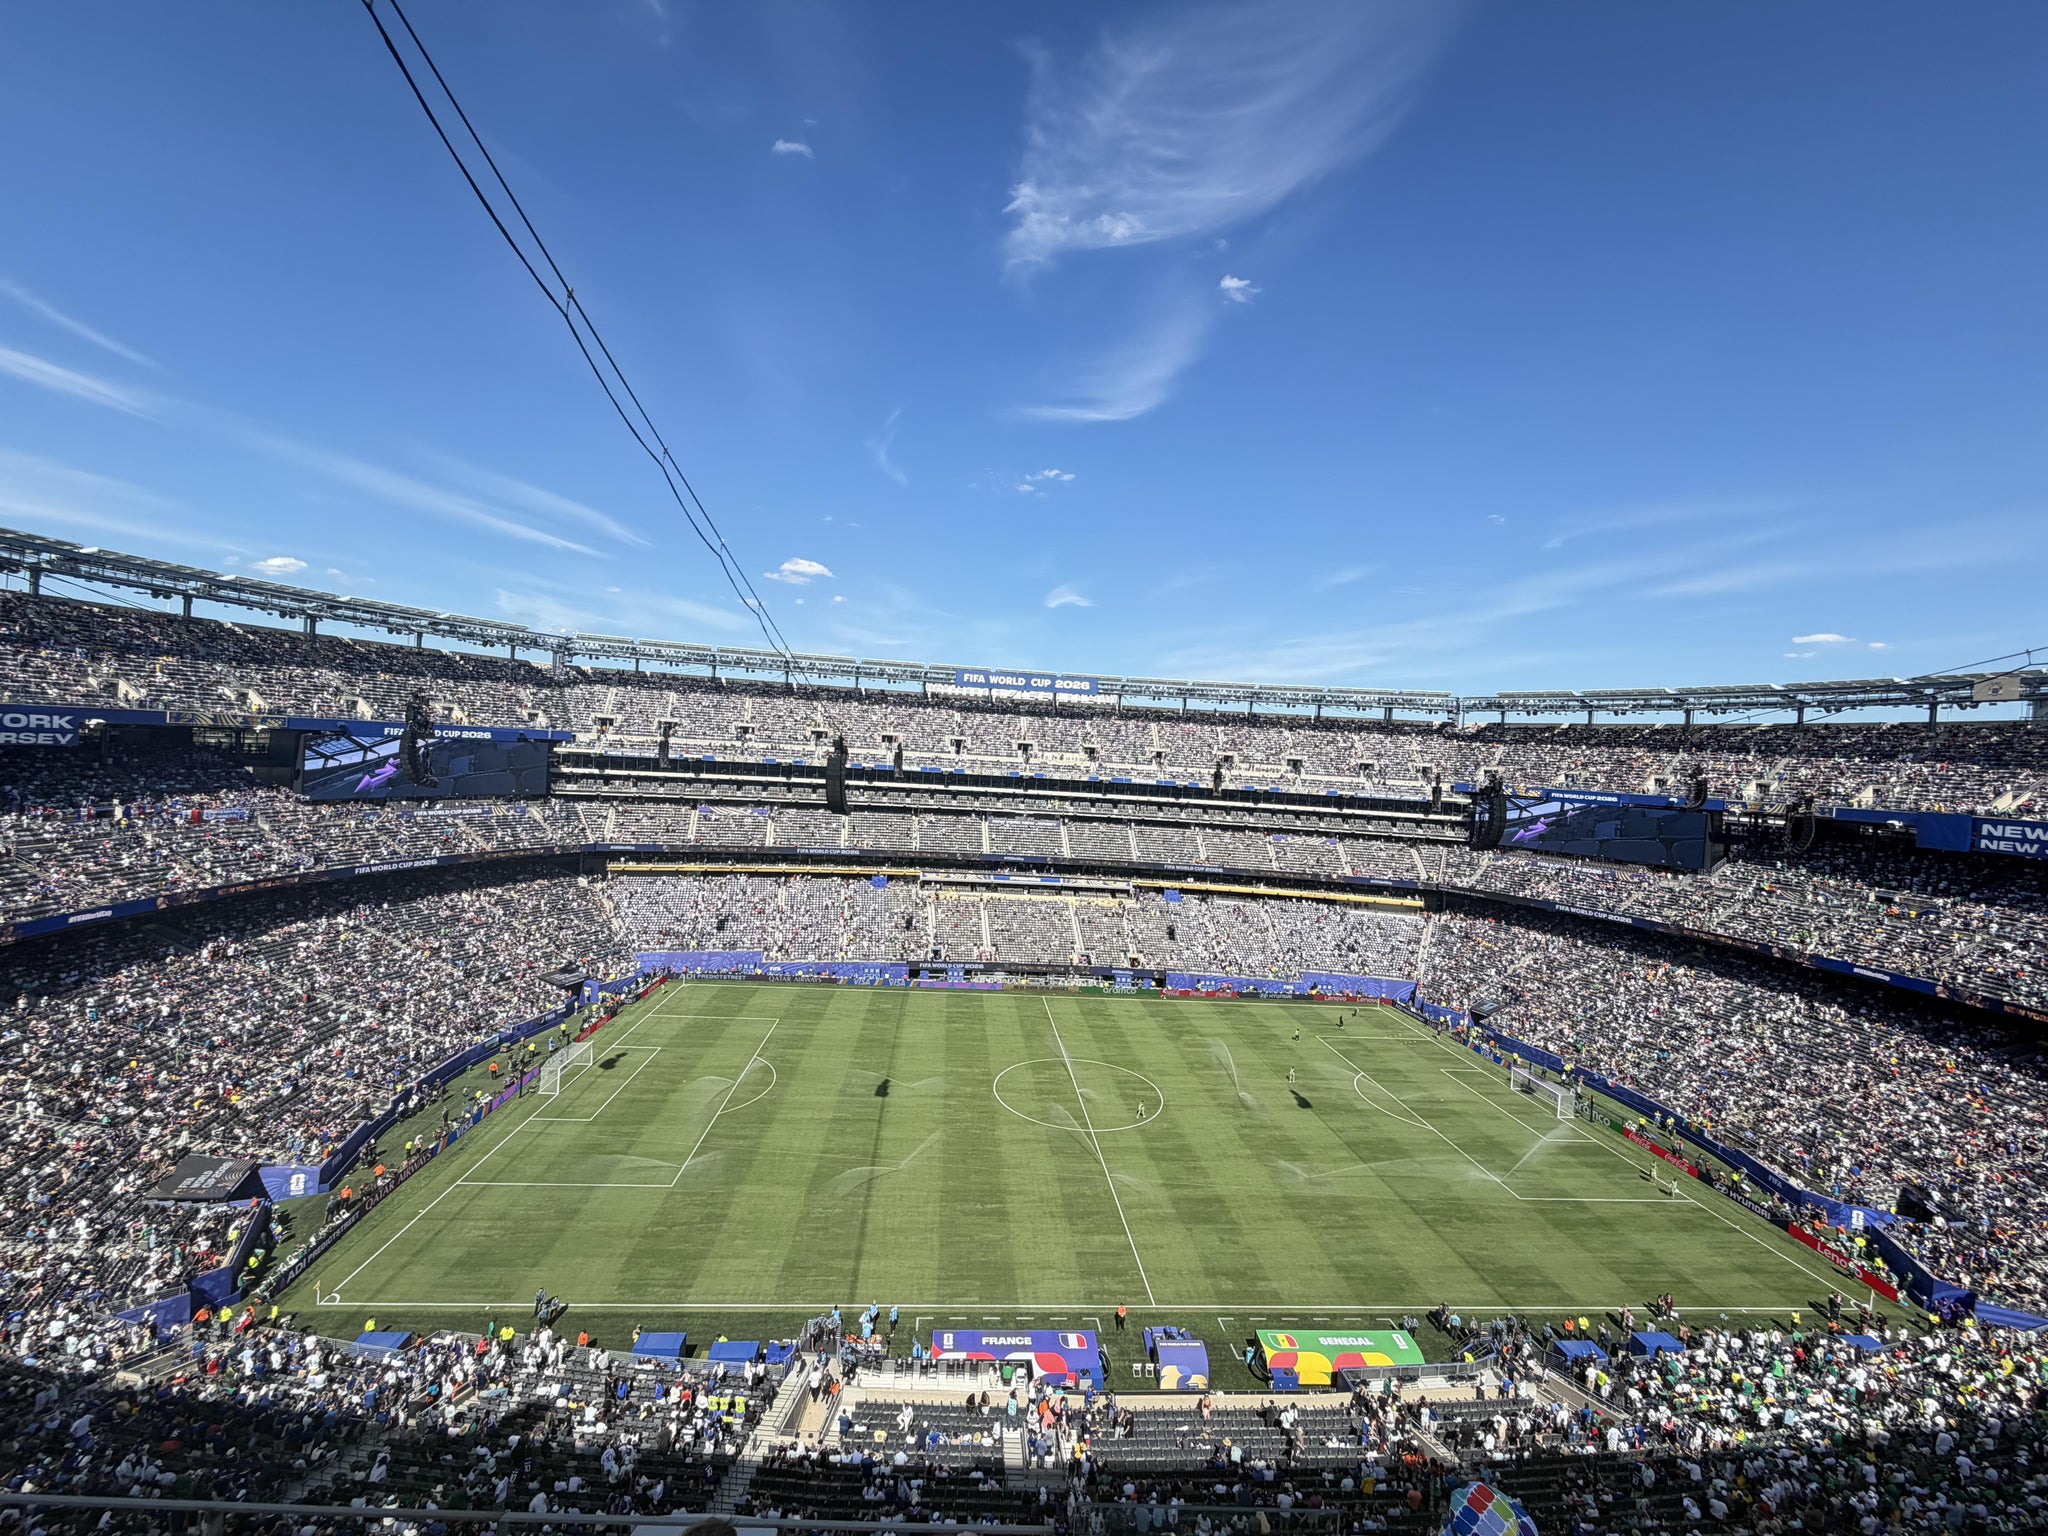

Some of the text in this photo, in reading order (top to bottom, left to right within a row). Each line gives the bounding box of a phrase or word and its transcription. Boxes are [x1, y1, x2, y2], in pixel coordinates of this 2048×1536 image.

[964, 673, 1090, 690] FIFA WORLD CUP 2026
[0, 713, 74, 729] ORK
[442, 730, 460, 738] CUP
[461, 731, 492, 739] 2026
[1982, 824, 2048, 841] NEW
[1980, 839, 2040, 854] NEW
[355, 859, 438, 875] FIFA WORLD CUP 2026
[1556, 904, 1570, 912] FIFA
[1570, 908, 1594, 916] WORLD
[1608, 915, 1633, 924] 2026
[794, 976, 822, 984] AIRWAYS
[854, 978, 871, 986] VISA
[889, 978, 906, 986] VISA
[1103, 987, 1137, 995] aramco
[1481, 1047, 1494, 1061] VISA
[456, 1118, 474, 1138] VISA
[1665, 1153, 1689, 1173] Coca-Cola
[365, 1153, 433, 1210] QATAR AIRWAYS
[1768, 1175, 1783, 1189] FIFA
[1730, 1190, 1771, 1220] HYUNDAI
[286, 1210, 361, 1284] ADI PREDICTSTREET
[1817, 1242, 1863, 1279] Lenoo
[982, 1336, 1032, 1346] FRANCE
[1318, 1337, 1375, 1346] SENEGAL
